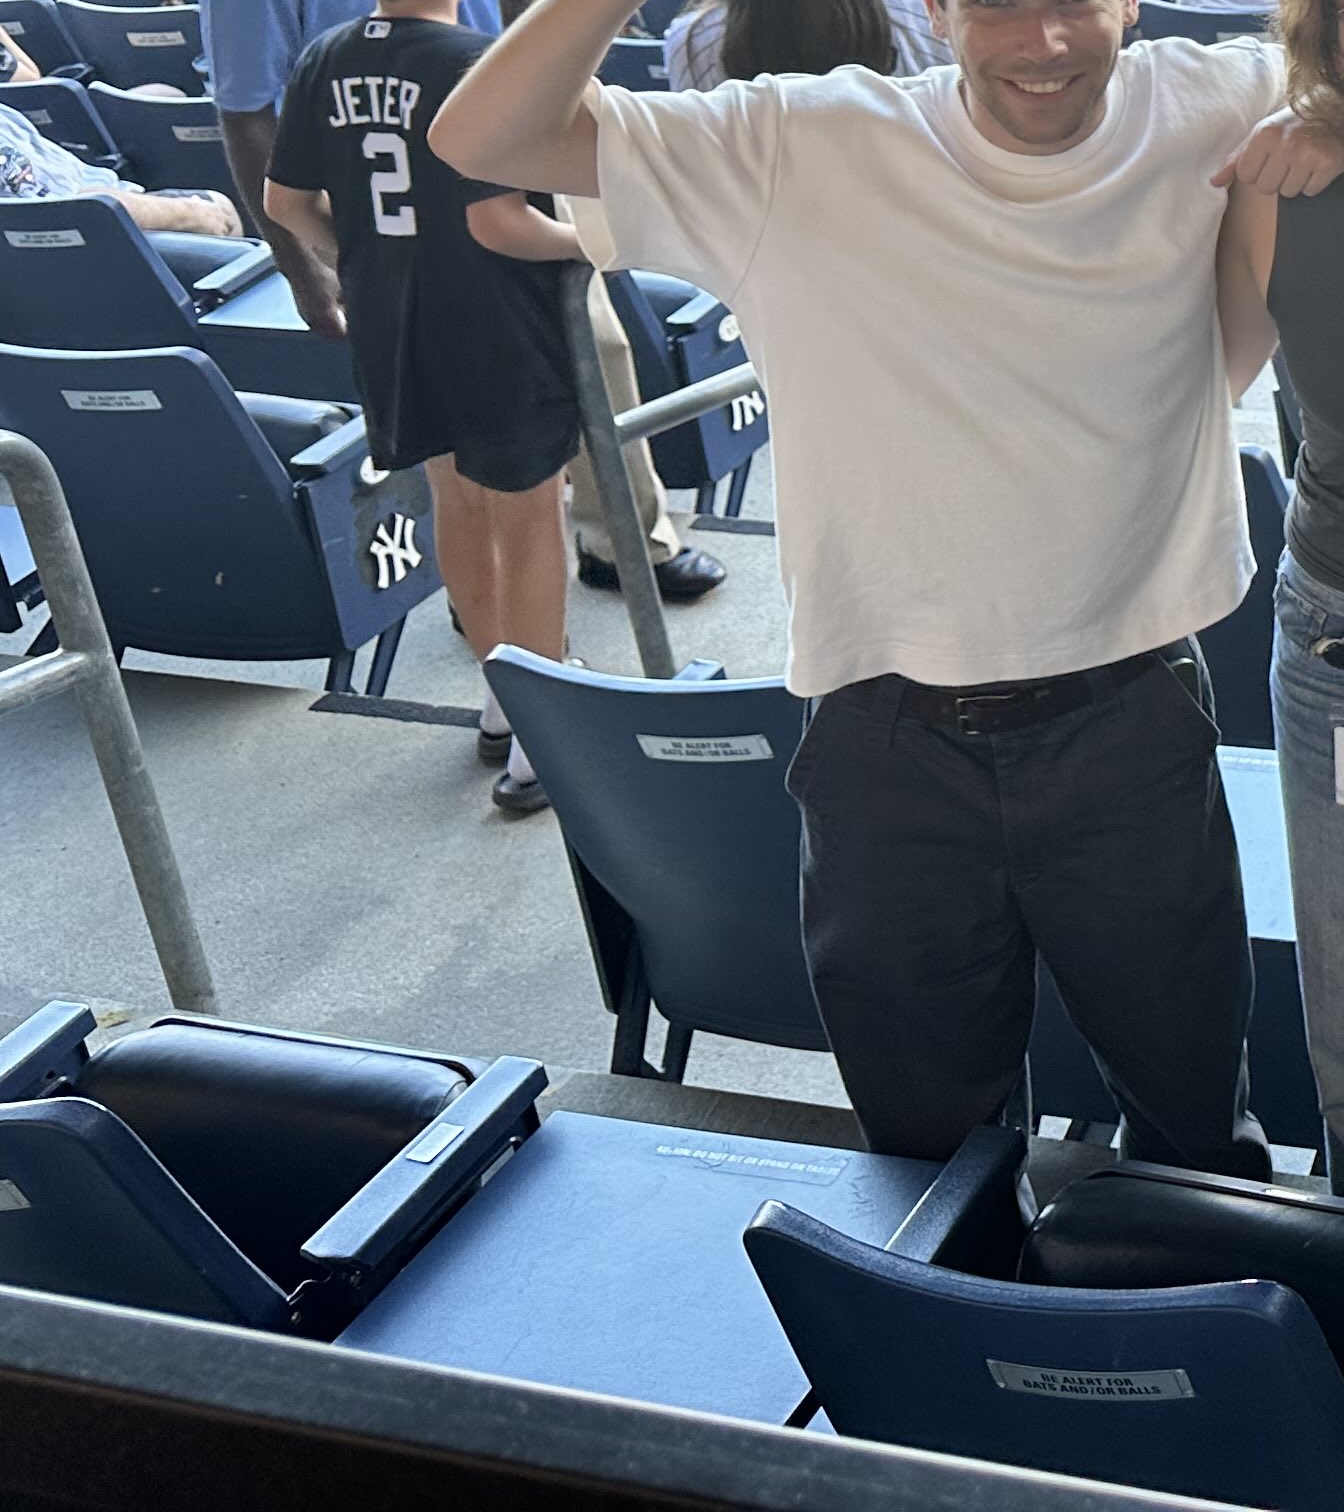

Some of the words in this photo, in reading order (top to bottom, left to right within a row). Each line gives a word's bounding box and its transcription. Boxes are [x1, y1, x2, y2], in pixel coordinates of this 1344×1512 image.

[328, 76, 421, 130] JETER
[362, 131, 418, 237] 2
[369, 513, 423, 590] NY
[1022, 1379, 1056, 1391] BATS
[1060, 1385, 1115, 1395] AND/OR
[1119, 1385, 1162, 1395] BALLS
[1040, 1373, 1057, 1383] BE
[1063, 1376, 1101, 1386] ALERT
[1106, 1377, 1133, 1386] FOR
